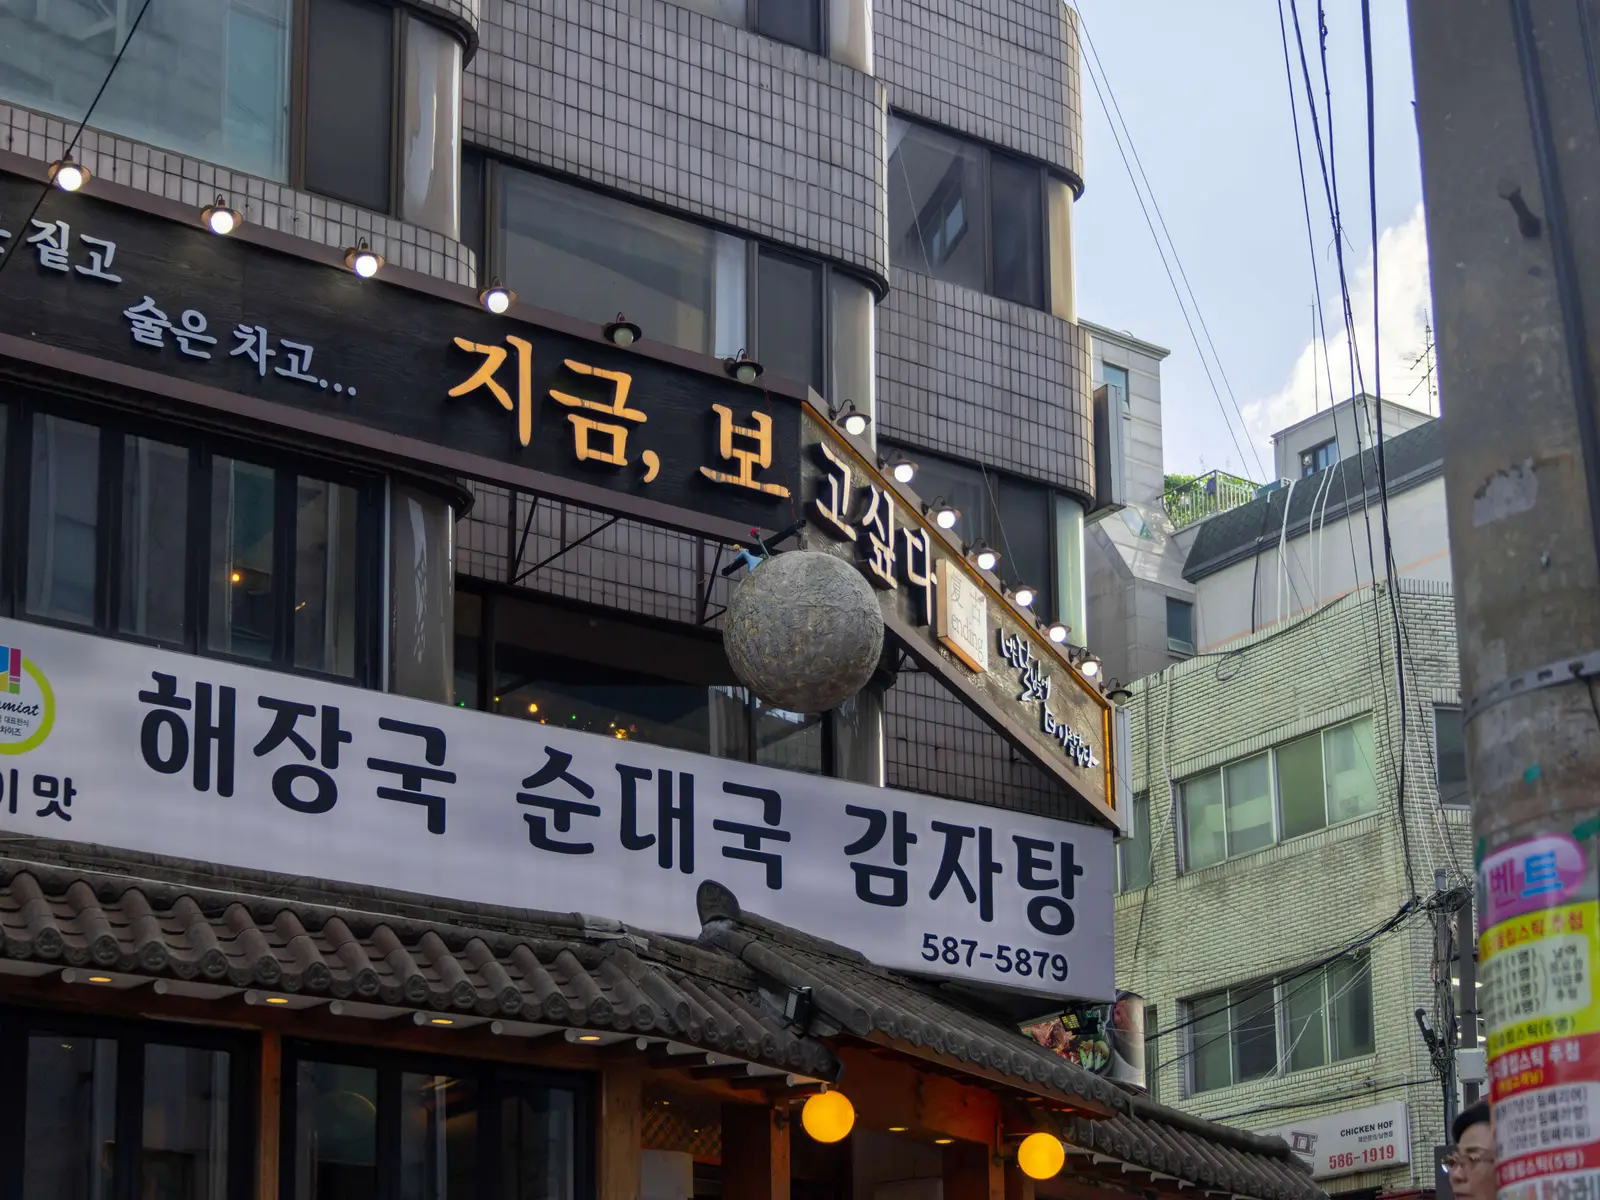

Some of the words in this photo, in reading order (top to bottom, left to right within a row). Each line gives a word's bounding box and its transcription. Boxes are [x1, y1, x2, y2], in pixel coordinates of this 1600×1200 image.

[27, 219, 122, 283] 짙고
[123, 295, 218, 359] 술은
[448, 334, 660, 484] 지금,
[951, 611, 985, 664] ending
[33, 774, 77, 822] 맛
[138, 671, 457, 835] 해장국
[516, 745, 791, 890] 순대국
[844, 804, 1084, 936] 감자탕
[921, 933, 1069, 982] 587-5879
[1340, 1124, 1375, 1137] CHICKEN
[1377, 1120, 1394, 1130] HOF
[1329, 1144, 1395, 1170] 586-1919
